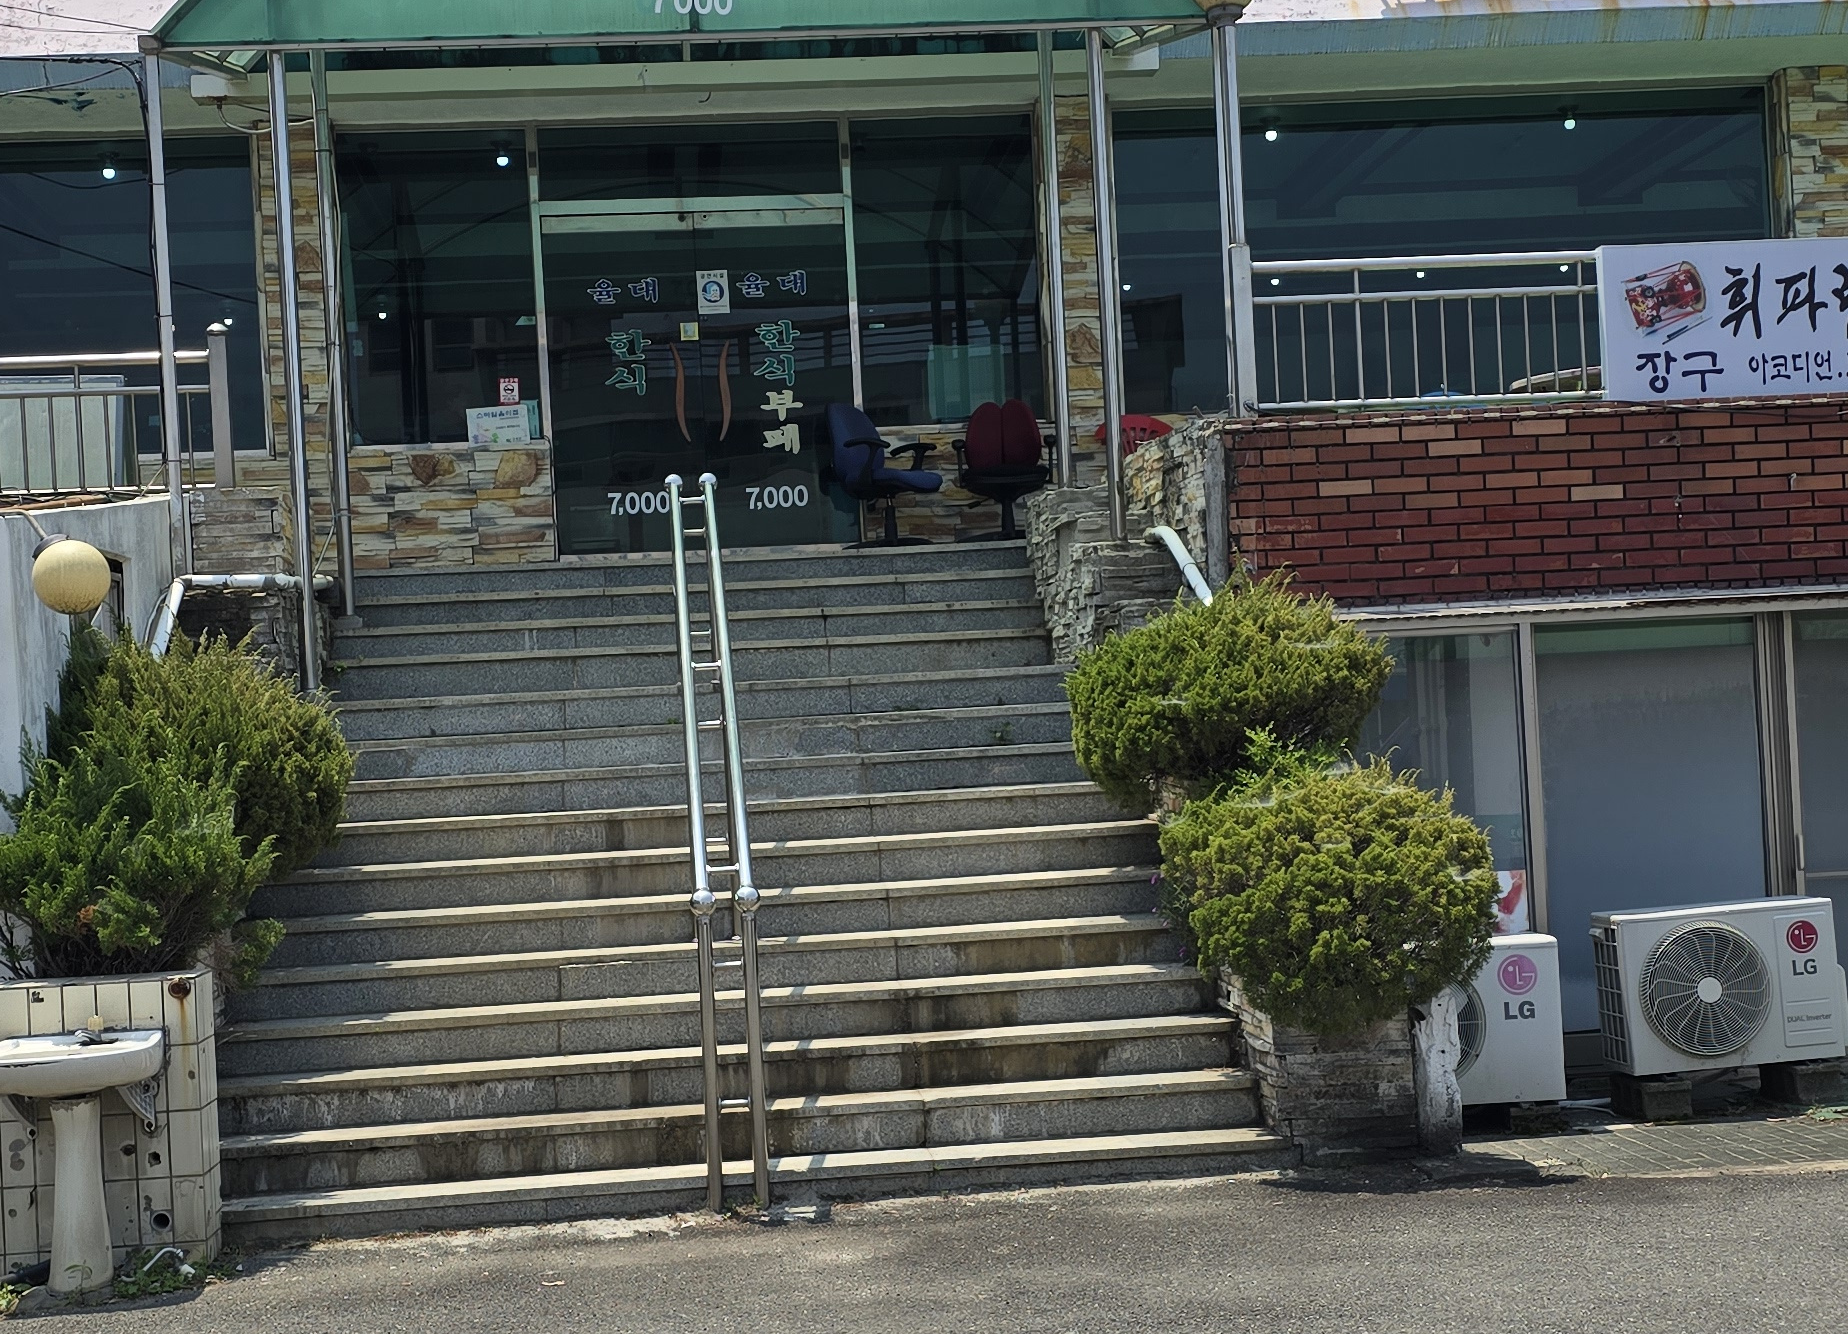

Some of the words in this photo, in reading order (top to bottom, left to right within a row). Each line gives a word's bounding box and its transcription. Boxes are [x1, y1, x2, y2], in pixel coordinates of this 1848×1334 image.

[587, 277, 659, 305] 율대
[736, 270, 808, 298] 율대
[1635, 350, 1725, 394] 장구
[607, 490, 671, 516] 7,000
[745, 484, 809, 511] 7,000
[1792, 958, 1818, 976] LG
[1503, 1000, 1536, 1020] LG
